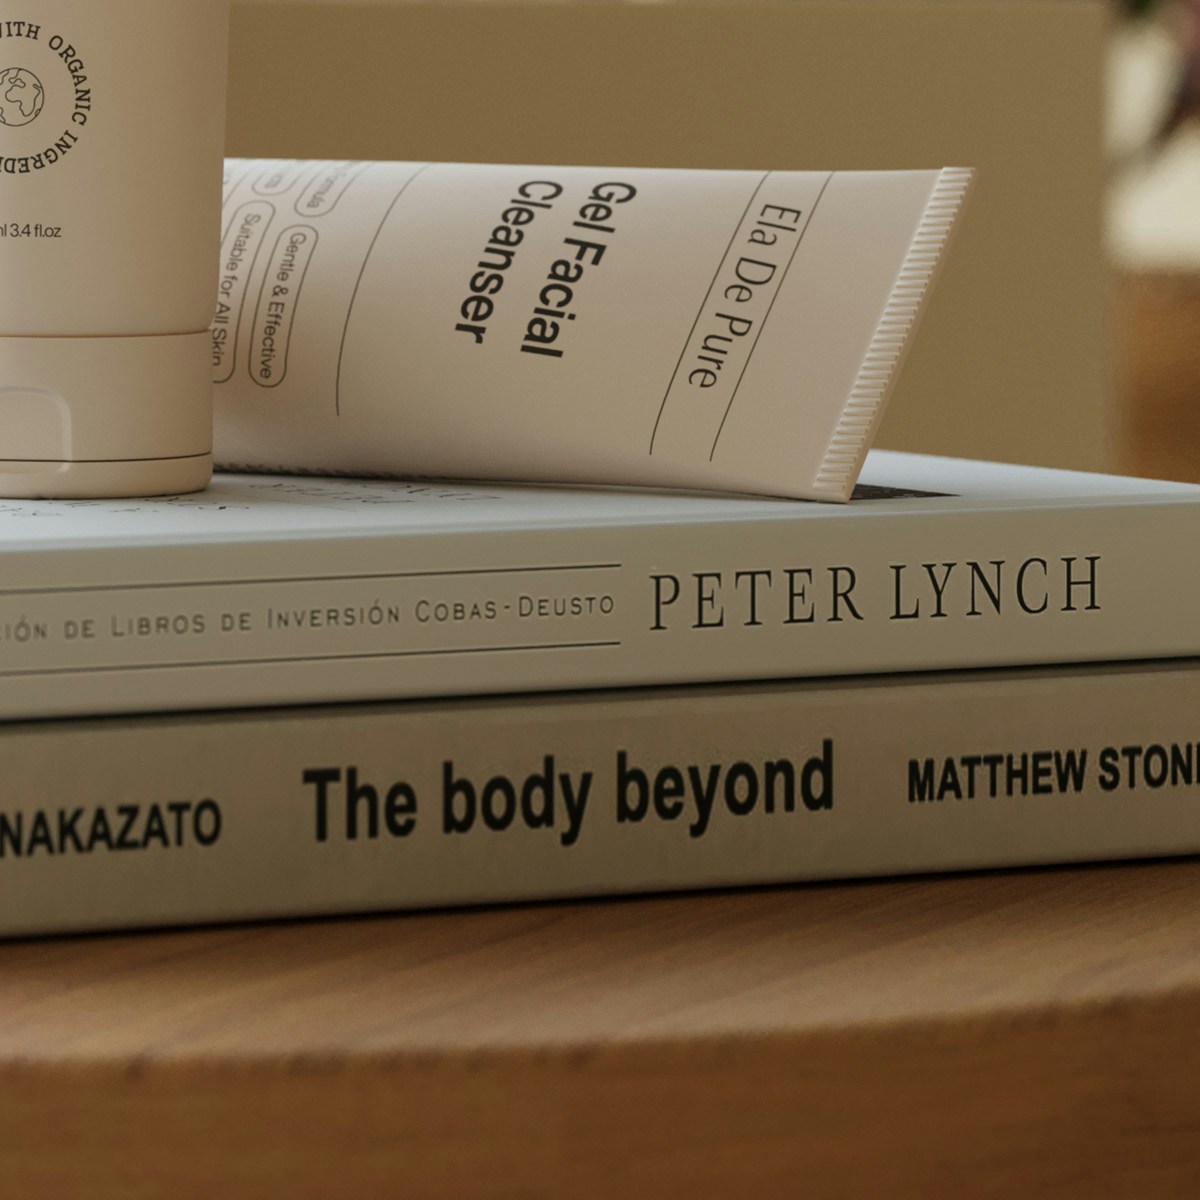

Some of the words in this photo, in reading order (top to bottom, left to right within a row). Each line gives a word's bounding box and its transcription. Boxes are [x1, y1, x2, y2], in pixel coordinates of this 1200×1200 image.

[48, 35, 92, 127] ORGANIC
[9, 223, 32, 238] 3.4
[34, 224, 62, 238] fl.oz
[569, 181, 637, 233] Gel
[746, 204, 802, 246] Ela
[225, 212, 261, 272] Suitable
[276, 232, 307, 282] Gentle
[454, 180, 563, 344] Cleanser
[219, 274, 238, 298] for
[271, 284, 289, 297] &
[520, 237, 607, 358] Facial
[723, 256, 777, 303] De
[212, 327, 227, 366] Skin
[259, 301, 285, 380] Effective
[688, 312, 753, 388] Pure
[63, 619, 95, 640] DE
[111, 613, 206, 637] LIBROS
[220, 612, 252, 632] DE
[267, 600, 400, 629] INVERSIÓN
[649, 567, 864, 631] PETER
[888, 555, 1102, 620] LYNCH
[303, 765, 417, 842] The
[442, 755, 593, 847] body
[617, 738, 834, 839] beyond
[907, 749, 1088, 804] MATTHEW
[1098, 742, 1200, 792] STON
